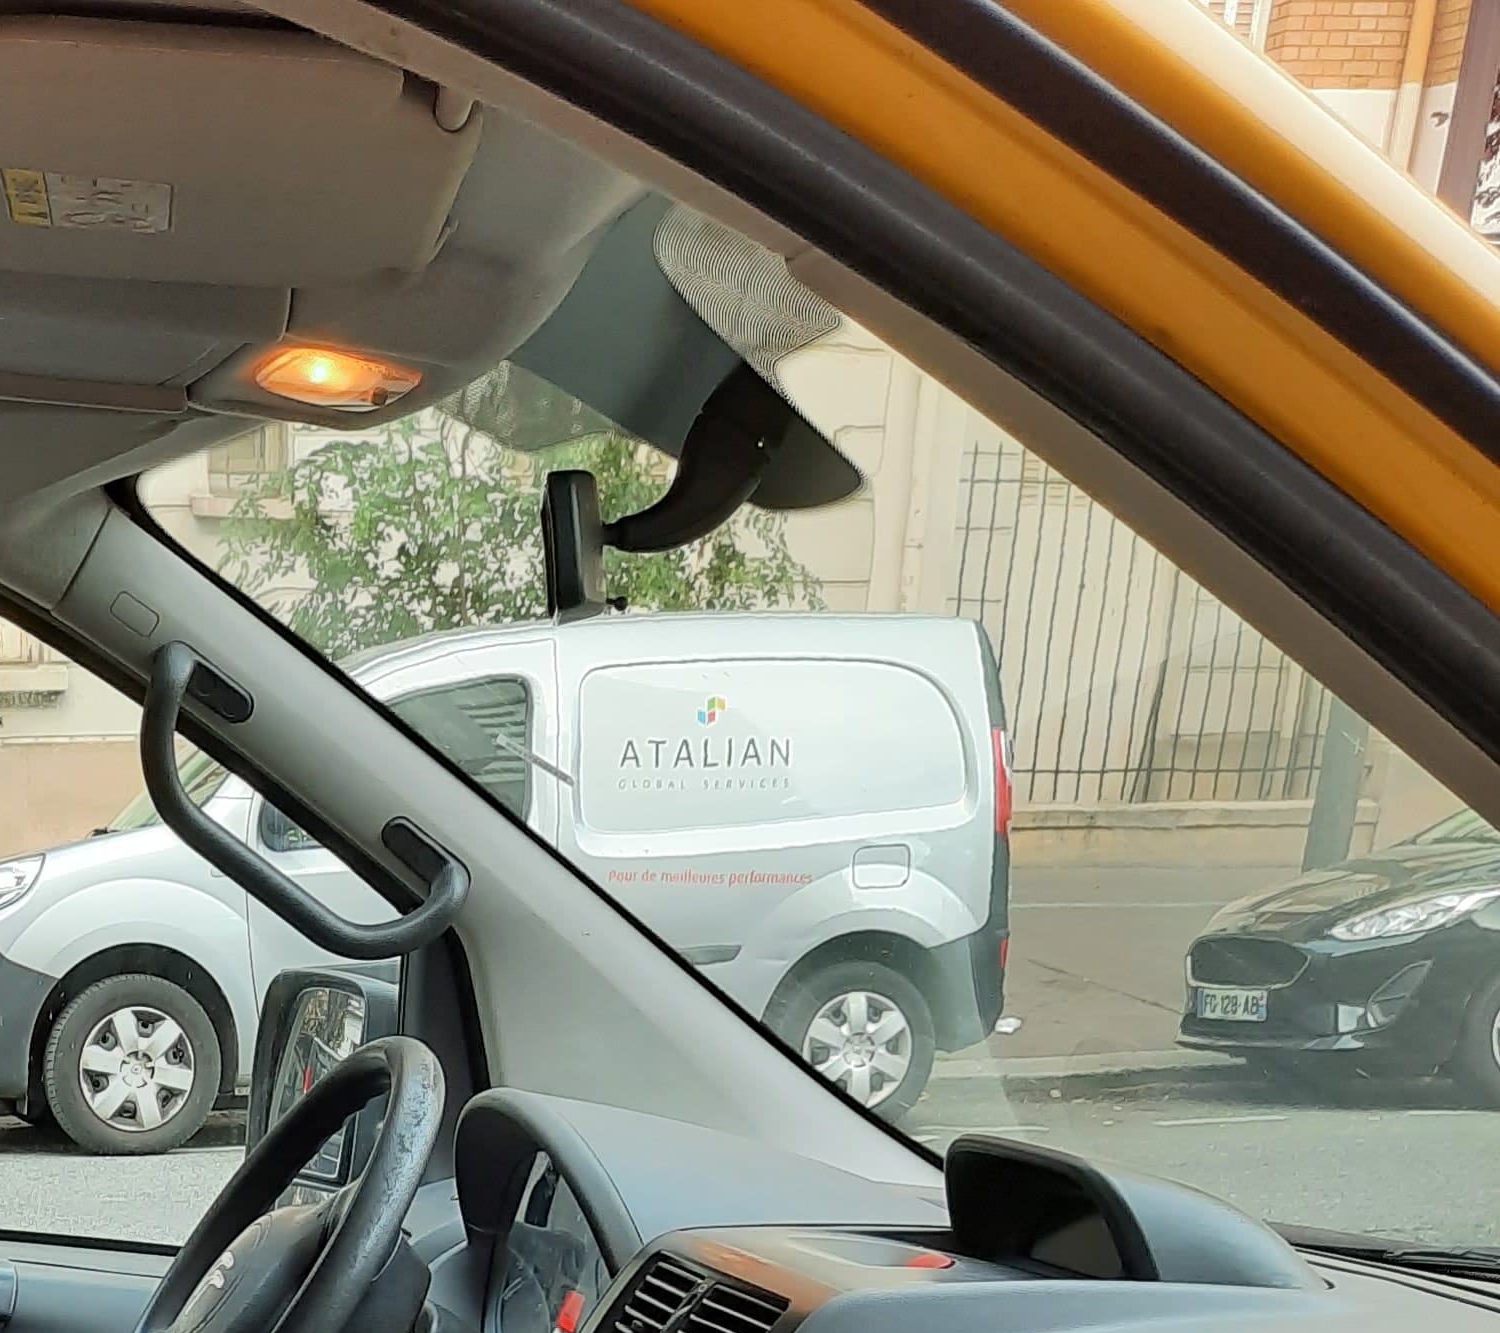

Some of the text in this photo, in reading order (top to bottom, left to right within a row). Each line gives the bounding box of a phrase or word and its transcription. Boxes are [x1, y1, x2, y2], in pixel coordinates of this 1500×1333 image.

[619, 737, 791, 768] ATALIAN
[617, 777, 791, 790] GLOBAL SERVICES
[607, 869, 638, 882] Pour
[641, 869, 657, 882] de
